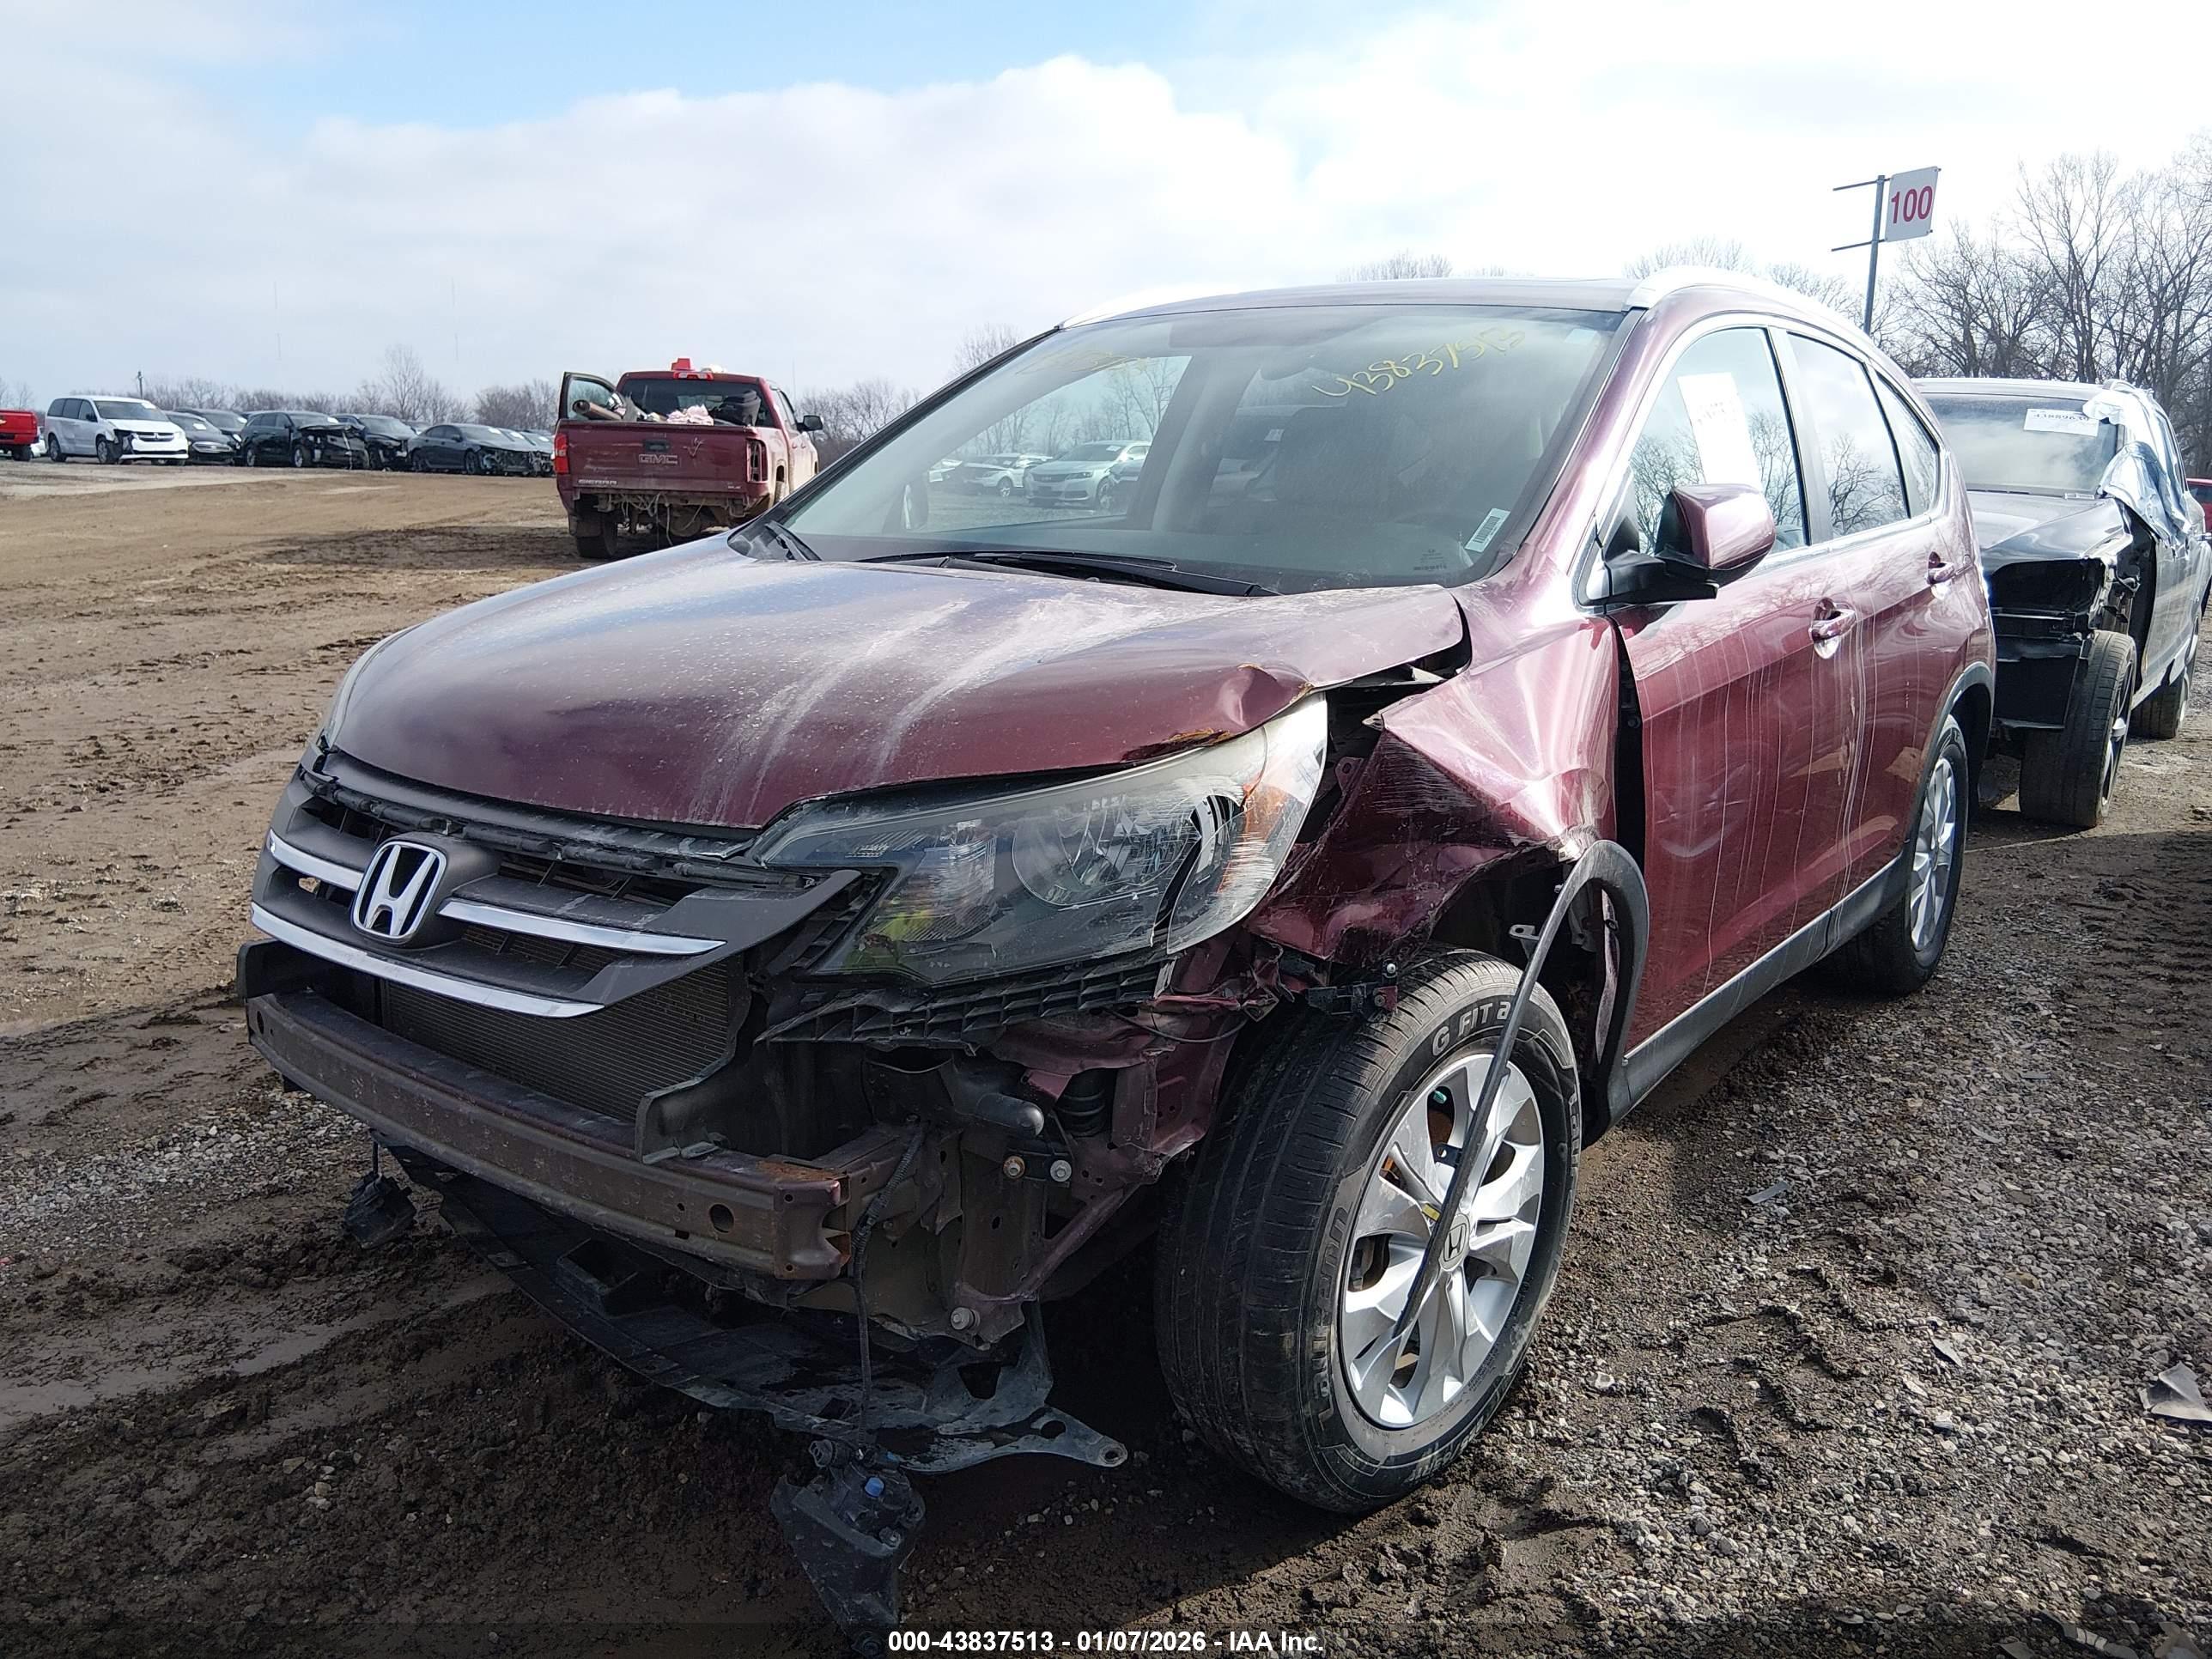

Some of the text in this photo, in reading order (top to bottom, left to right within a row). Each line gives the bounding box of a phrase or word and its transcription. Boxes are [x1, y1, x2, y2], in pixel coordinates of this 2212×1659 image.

[1891, 185, 1933, 224] 100
[638, 453, 678, 465] GMC
[1432, 1025, 1450, 1056] G
[1457, 1002, 1493, 1037] FIT
